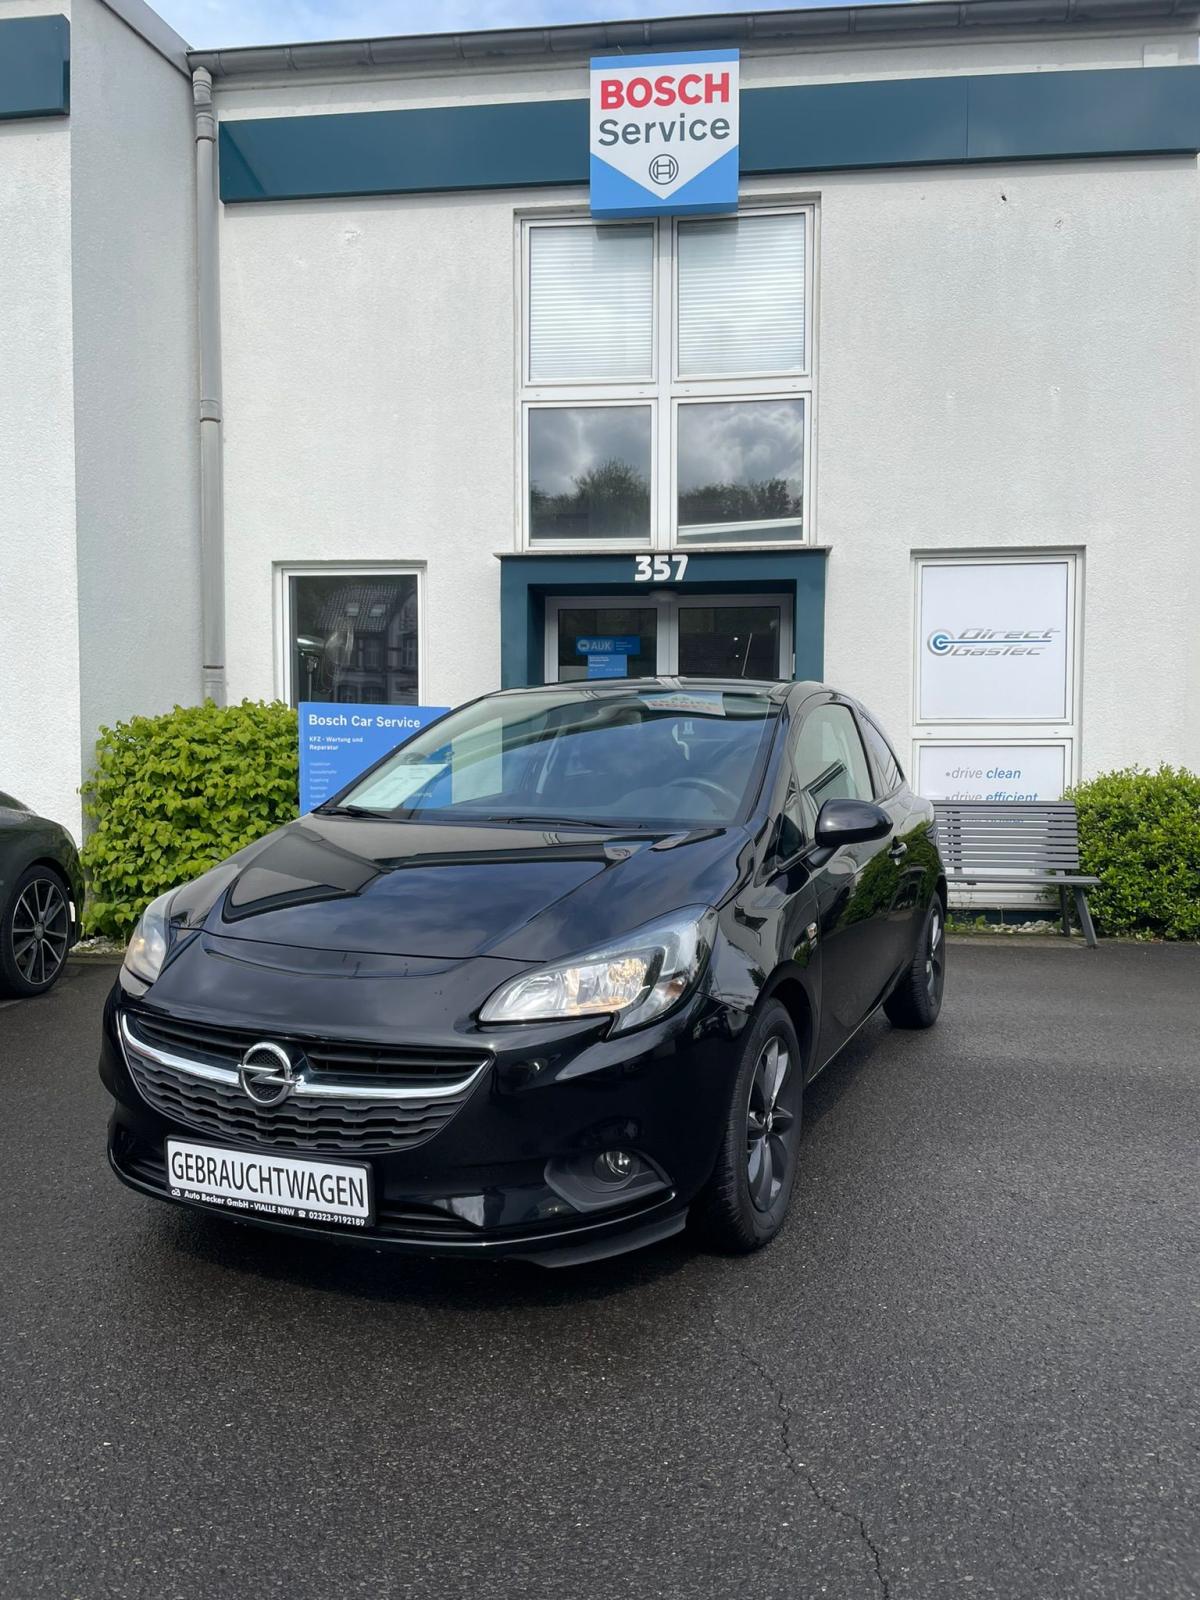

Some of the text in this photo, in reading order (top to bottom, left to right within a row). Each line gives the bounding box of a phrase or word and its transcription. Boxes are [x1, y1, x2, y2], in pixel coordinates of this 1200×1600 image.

[601, 72, 730, 110] BOSCH
[598, 113, 730, 146] Service
[634, 555, 689, 581] 357
[958, 628, 1061, 640] Direct
[951, 644, 1046, 656] GasTec
[309, 714, 421, 728] Bosch Car Service
[951, 768, 1021, 779] drive clean
[985, 792, 1039, 801] efficient
[171, 1151, 364, 1208] GEBRAUCHTWAGEN
[184, 1190, 201, 1200] Auto
[201, 1193, 225, 1205] Becker
[226, 1198, 249, 1209] GmbH
[254, 1203, 276, 1213] VIALLE
[277, 1206, 295, 1216] NRW
